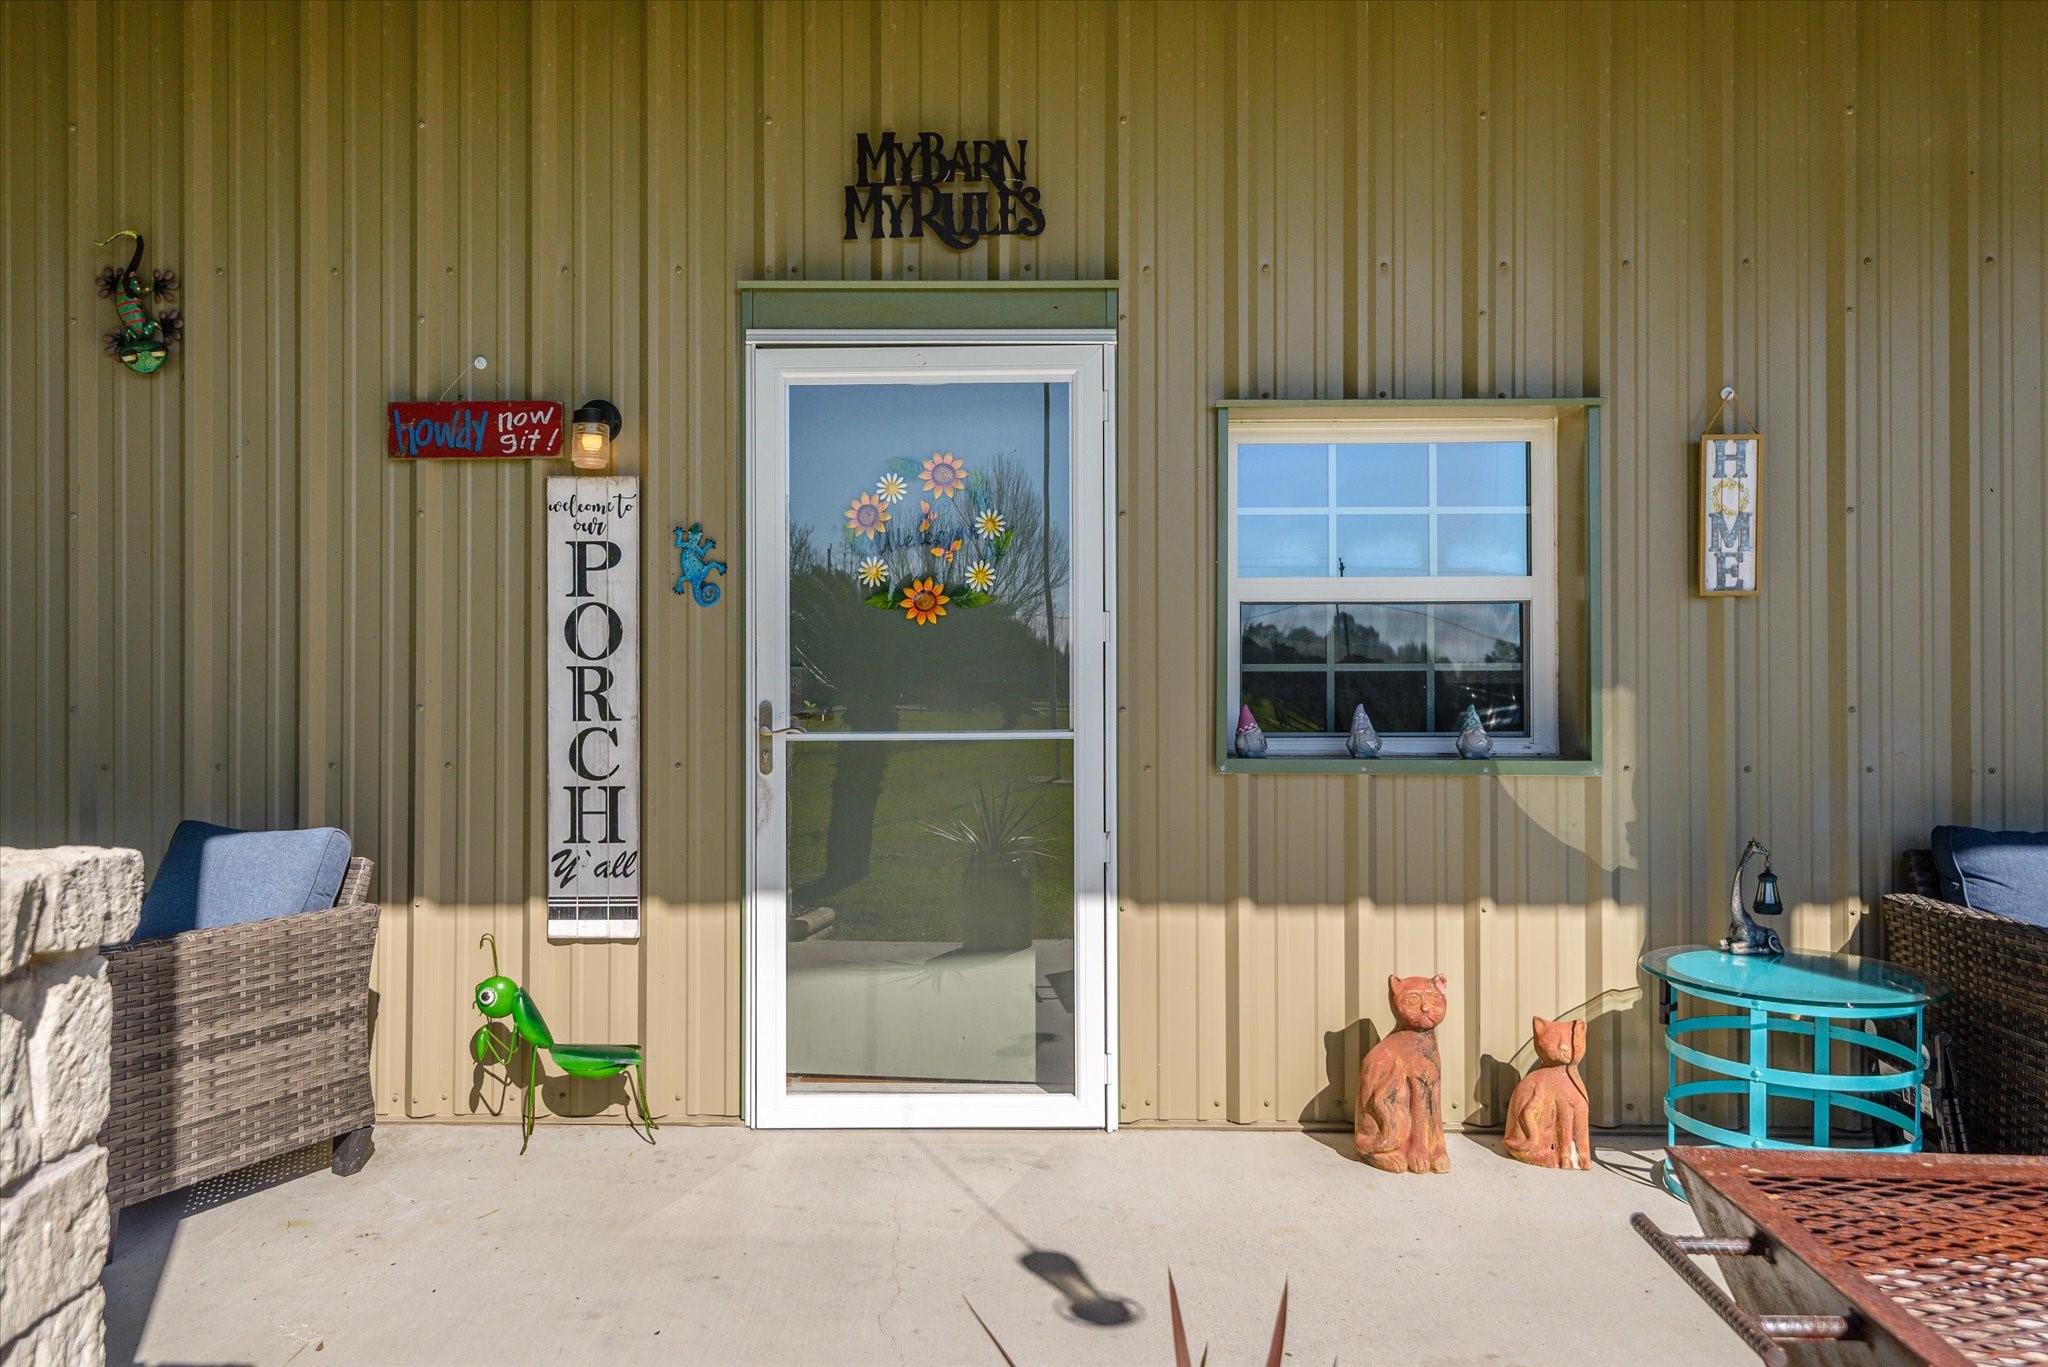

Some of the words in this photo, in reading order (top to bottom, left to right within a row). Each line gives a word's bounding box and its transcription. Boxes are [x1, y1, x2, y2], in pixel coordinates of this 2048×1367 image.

[498, 407, 554, 432] now
[394, 409, 489, 456] howdy
[549, 494, 615, 518] welcome
[613, 493, 637, 518] to
[573, 517, 607, 535] our
[563, 540, 626, 844] PORCH
